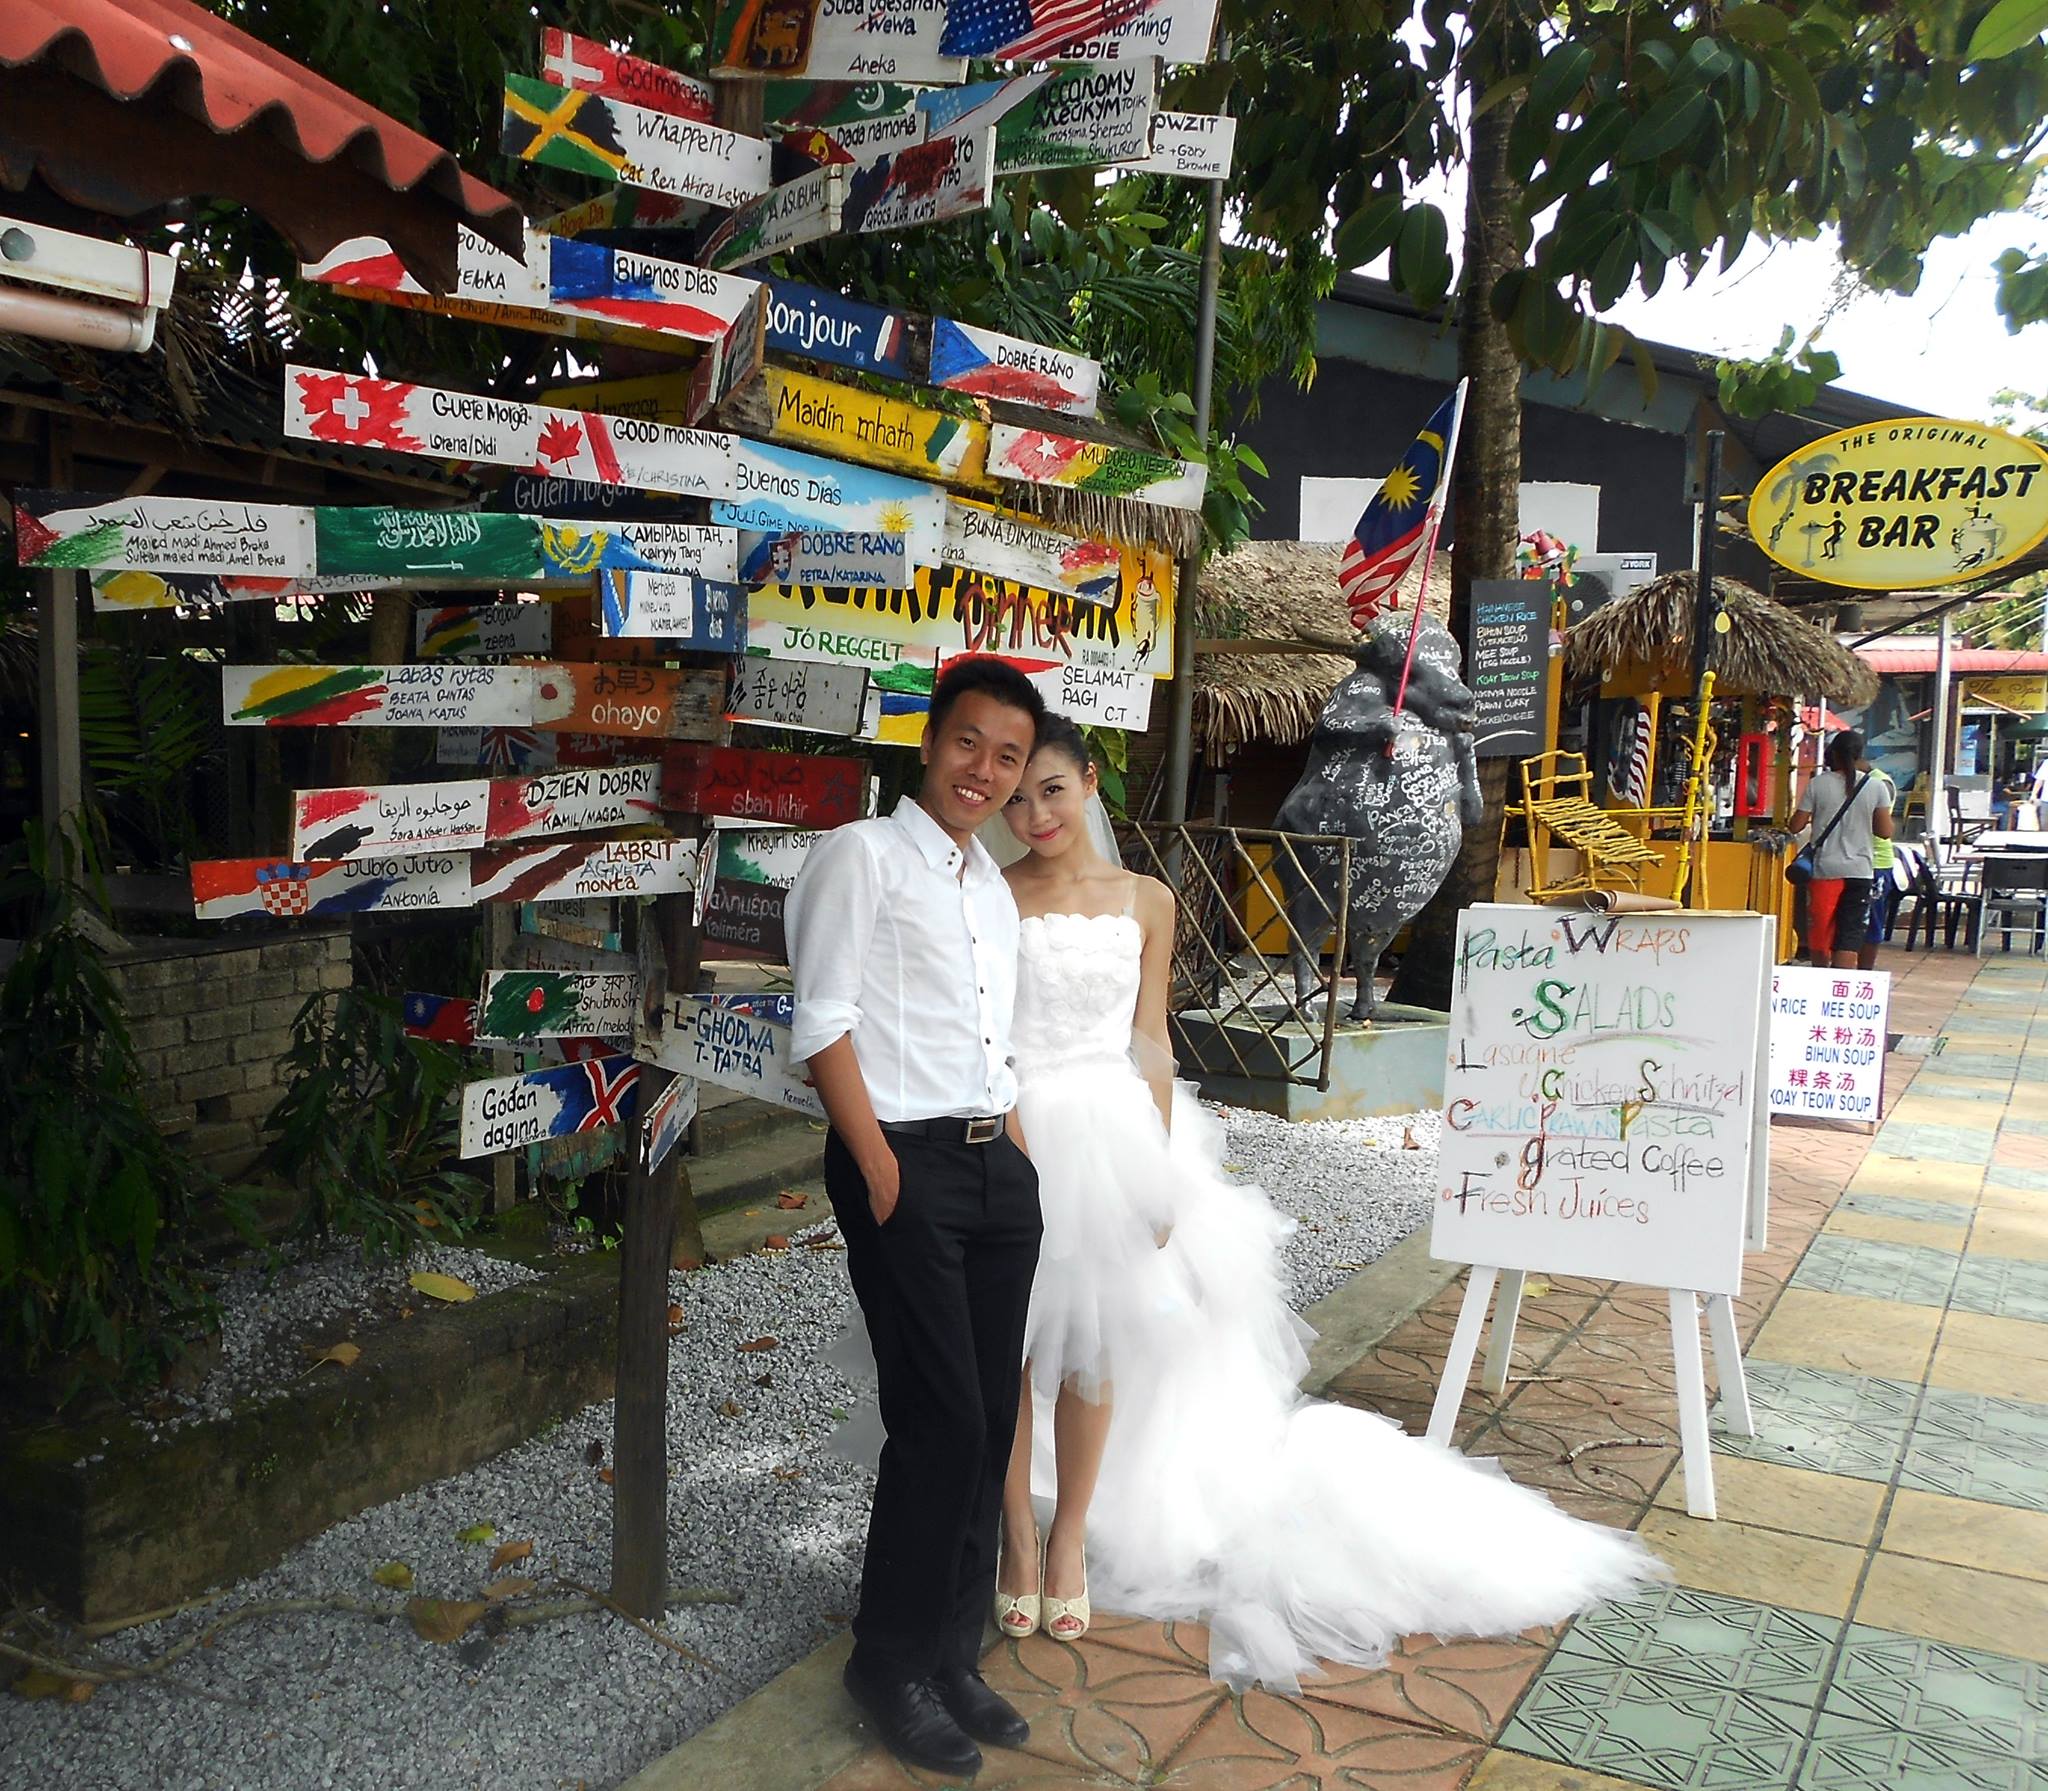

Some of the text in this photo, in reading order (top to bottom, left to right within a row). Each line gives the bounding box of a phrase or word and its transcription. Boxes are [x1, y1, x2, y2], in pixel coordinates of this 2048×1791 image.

[1059, 41, 1120, 60] EDDIE
[847, 54, 896, 75] Aneka
[637, 112, 736, 161] Whappen?
[837, 122, 865, 148] Dada
[432, 391, 483, 421] Guete
[777, 385, 915, 451] Maidin mhath
[613, 418, 660, 444] GOOD
[1840, 427, 1988, 452] THE ORIGINAL
[736, 463, 800, 498] Buenos
[1106, 466, 1153, 486] BONJOUR
[1802, 463, 2042, 506] BREAKFAST
[514, 475, 568, 510] Guten
[1856, 514, 1942, 550] BAR
[818, 631, 904, 662] REGGELT
[386, 665, 495, 692] Labas rytas
[1062, 666, 1135, 691] SELAMAT
[389, 689, 430, 705] BEATA
[1062, 688, 1098, 708] PAGI
[385, 706, 425, 722] JOANA
[590, 700, 661, 731] ohayo
[1391, 747, 1433, 767] Coffee
[526, 768, 653, 807] DZIEŃ DOBRY
[731, 789, 773, 816] Sbah
[541, 806, 626, 832] KAMIL/MAGDA
[402, 858, 453, 876] Jutro
[575, 872, 640, 895] monta
[1459, 929, 1556, 994] Pasta
[1831, 980, 1875, 1001] 面汤
[1528, 979, 1677, 1040] SALADS
[1780, 998, 1807, 1016] RICE
[1821, 1001, 1882, 1021] MEE SOUP
[673, 1000, 775, 1056] L-GHODWA
[1808, 1024, 1877, 1048] 米粉汤
[693, 1040, 763, 1081] T-TAJBA
[1805, 1045, 1877, 1067] BIHUN SOUP
[1788, 1067, 1856, 1092] 粿条汤
[1802, 1091, 1836, 1110] TEOW
[1839, 1094, 1872, 1113] SOUP
[1516, 1134, 1725, 1192] grated Coffee
[1453, 1170, 1649, 1225] Fresh Juices
